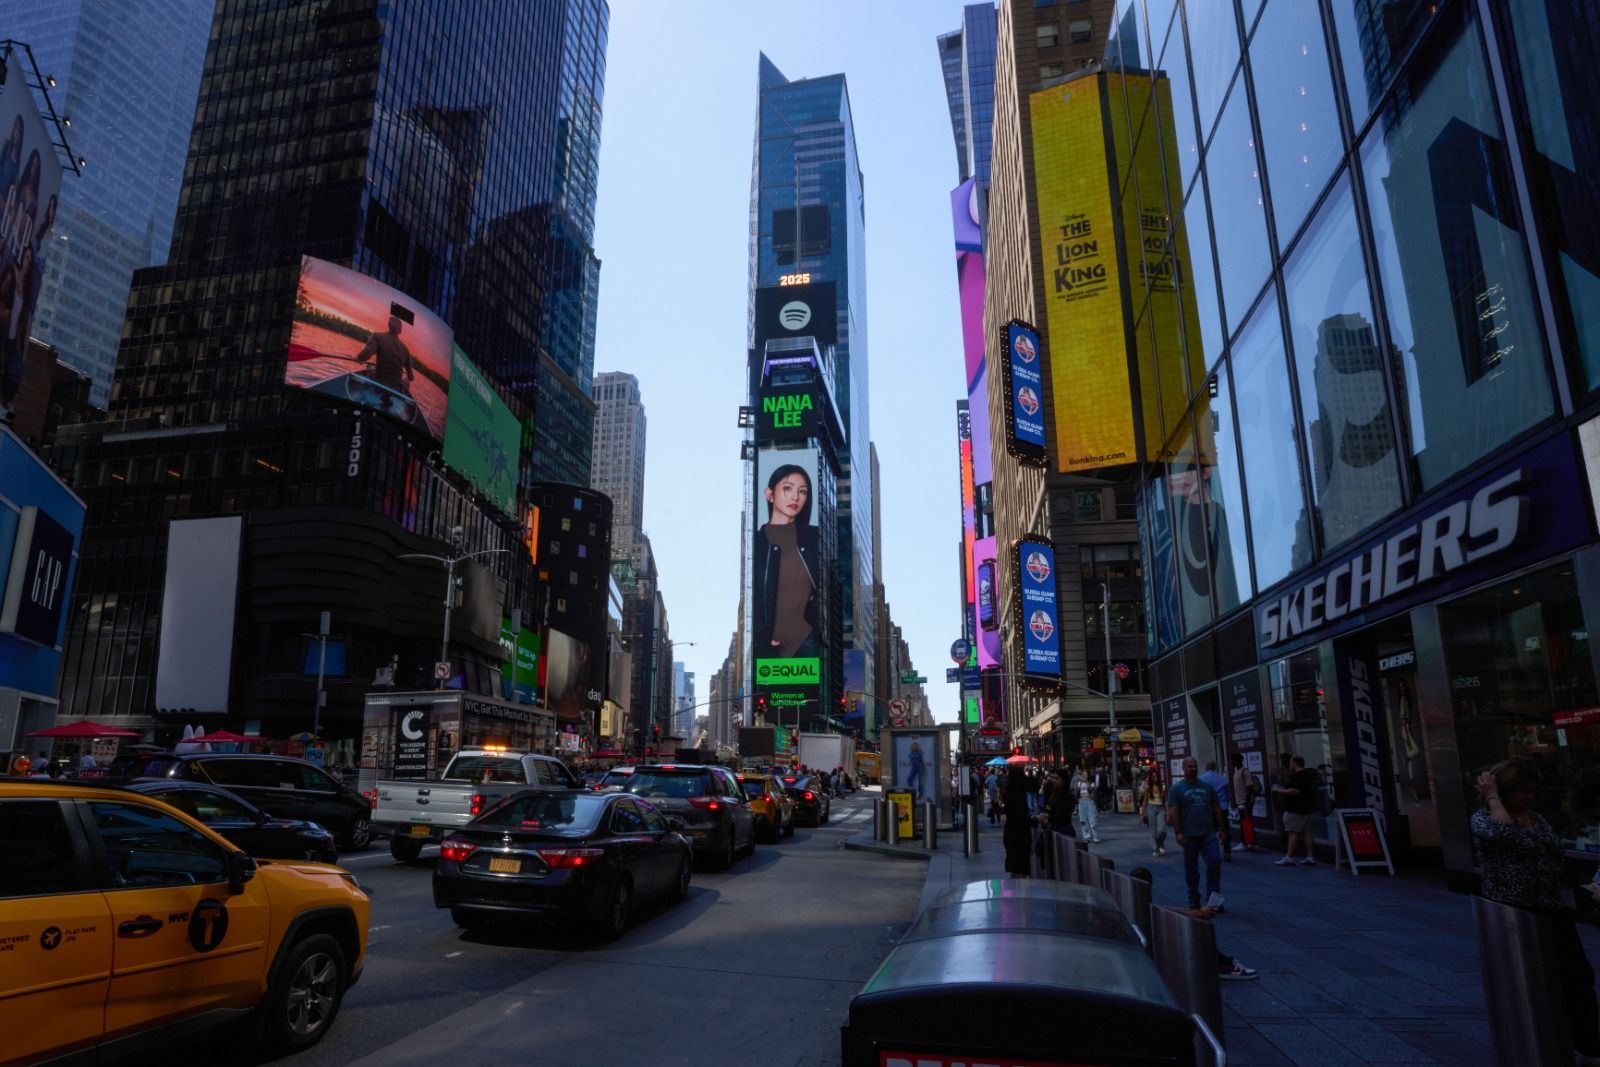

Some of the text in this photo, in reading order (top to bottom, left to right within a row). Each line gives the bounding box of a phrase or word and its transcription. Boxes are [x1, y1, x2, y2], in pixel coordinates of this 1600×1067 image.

[1060, 220, 1091, 237] THE
[779, 273, 811, 286] 2025
[763, 393, 813, 413] NANA
[773, 410, 803, 428] LEE
[348, 422, 362, 477] 1500
[1069, 450, 1126, 466] lionking.com
[1260, 467, 1525, 650] SKECHERS
[32, 549, 63, 611] GAP
[1024, 588, 1055, 598] BUBBA GUMP
[1026, 594, 1044, 602] SHRIMP
[1027, 648, 1043, 656] BUBBA
[1030, 654, 1047, 662] SHRIMP
[772, 665, 817, 677] EQUAL
[770, 691, 799, 699] Women
[401, 710, 424, 740] C
[168, 912, 189, 924] NYC
[199, 908, 221, 945] T
